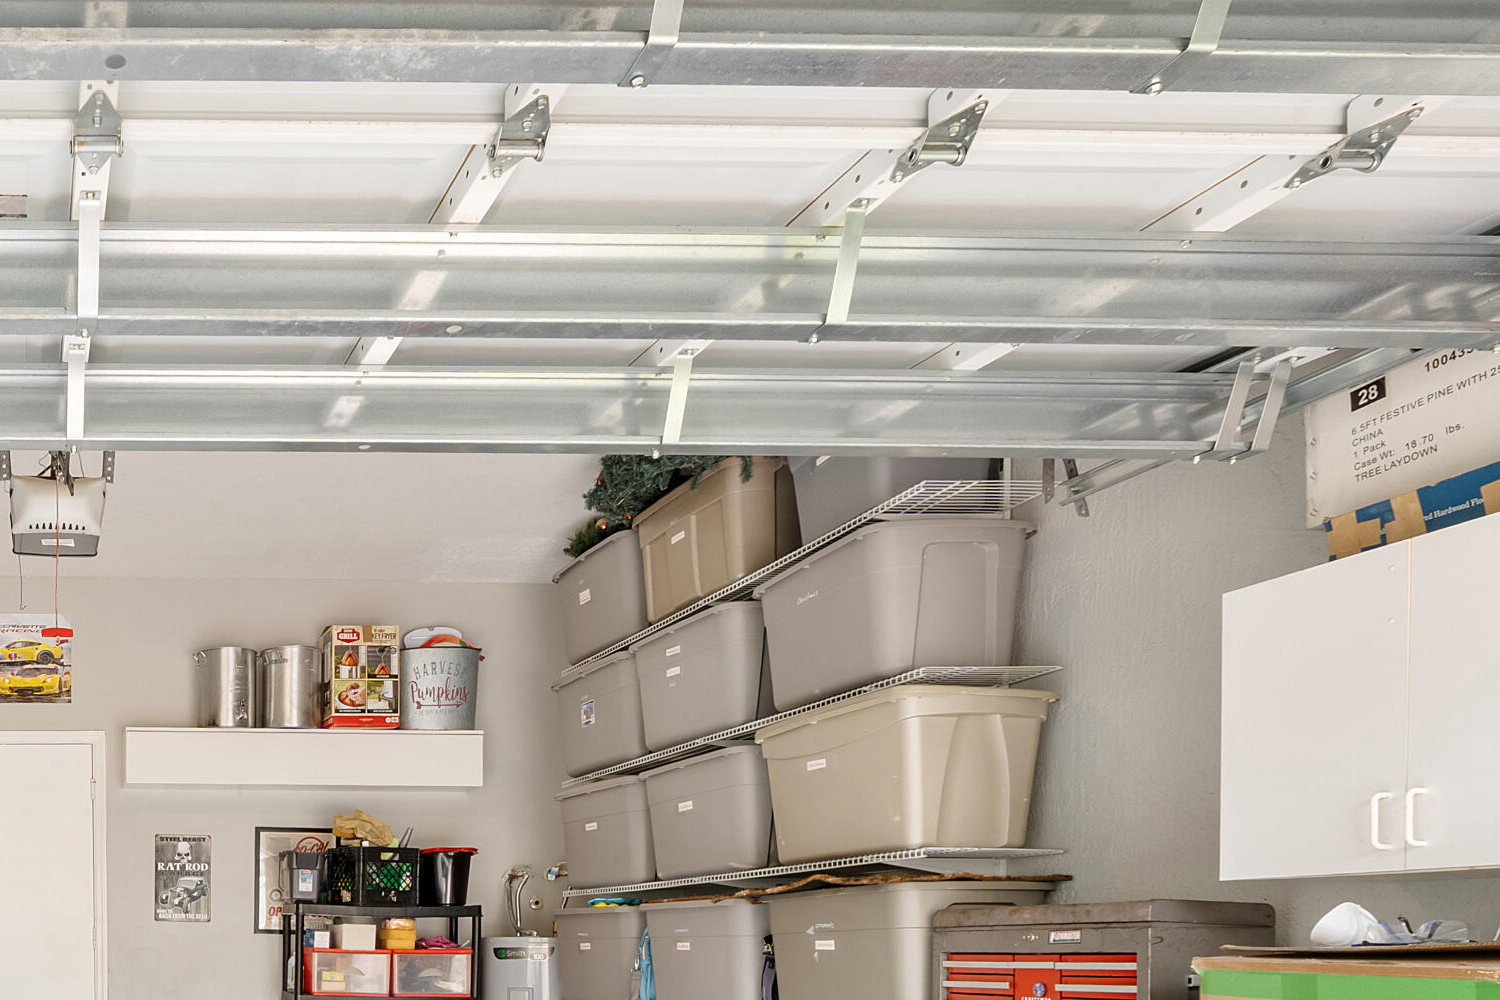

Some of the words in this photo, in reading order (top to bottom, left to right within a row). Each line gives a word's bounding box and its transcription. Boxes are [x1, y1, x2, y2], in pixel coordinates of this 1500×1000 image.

[1351, 418, 1377, 436] 6.5FT
[1380, 398, 1424, 423] FESTIVE
[1427, 385, 1454, 403] PINE
[1456, 371, 1488, 391] WITH
[1357, 385, 1379, 406] 28
[1351, 428, 1383, 447] CHINA
[1354, 456, 1378, 471] Case
[1405, 433, 1434, 451] 18.70
[1445, 423, 1465, 435] lbs.
[1363, 440, 1386, 455] Pack
[1354, 466, 1382, 482] TREE
[1384, 444, 1438, 472] LAYDOWN
[1433, 501, 1470, 520] Hardwood
[408, 676, 468, 709] Pumpkins
[157, 862, 182, 871] RAT
[185, 862, 209, 872] ROD
